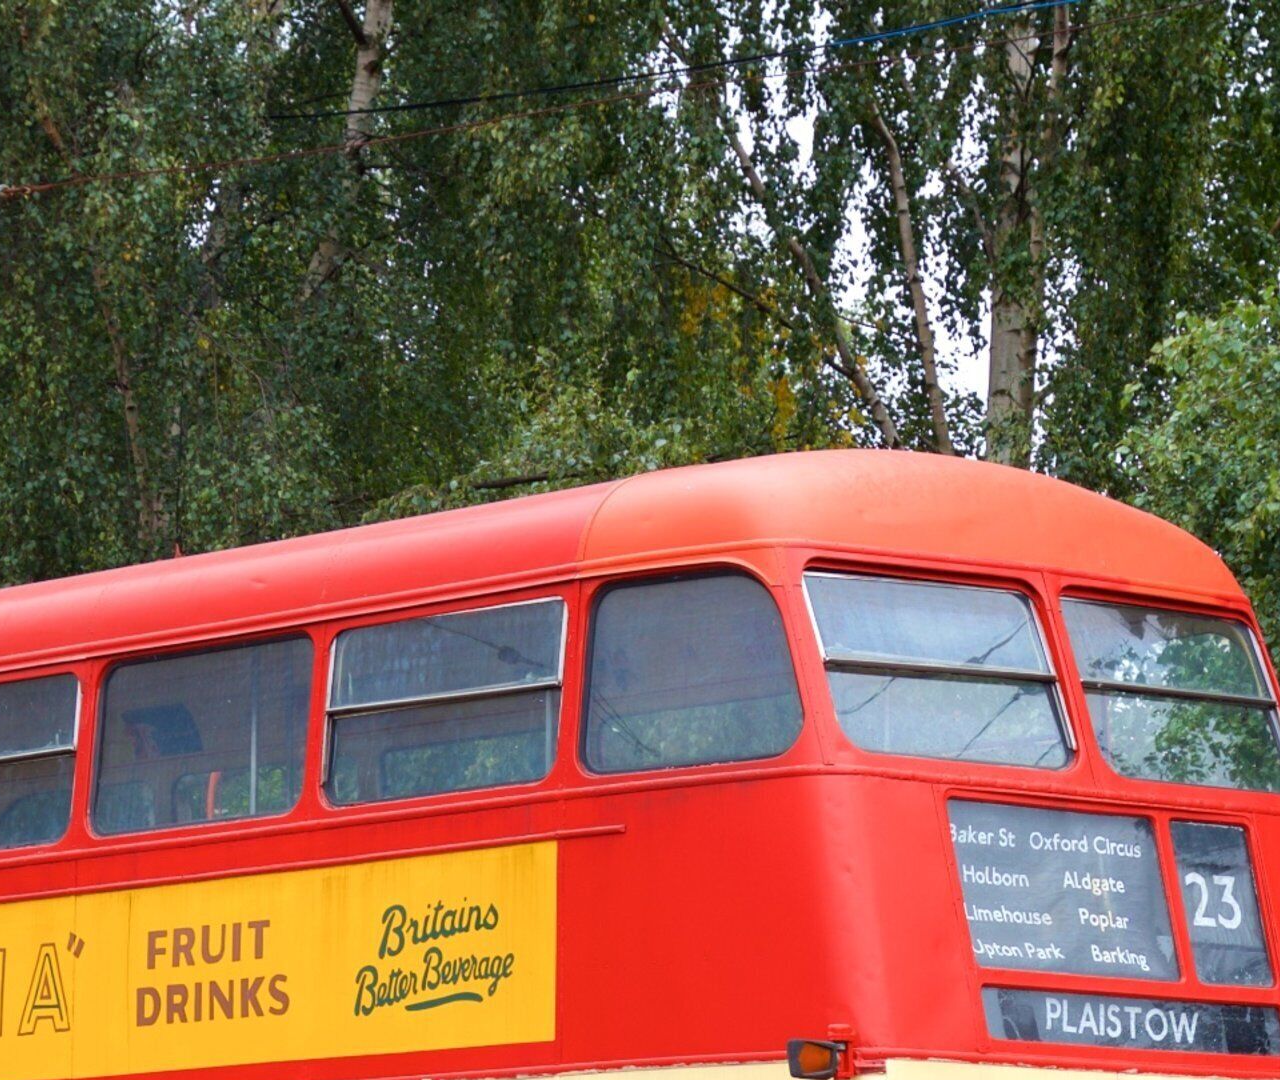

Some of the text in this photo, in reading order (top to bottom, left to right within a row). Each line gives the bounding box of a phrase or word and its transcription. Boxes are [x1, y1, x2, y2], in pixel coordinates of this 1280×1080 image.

[998, 828, 1016, 848] St
[1029, 831, 1142, 858] Oxford Circus
[962, 864, 1030, 888] Holborn
[1063, 870, 1125, 896] Aldgate
[963, 902, 1053, 925] Limehouse
[1184, 872, 1243, 929] 23
[378, 897, 499, 959] Britains
[1078, 907, 1129, 932] Poplar
[146, 920, 271, 970] FRUIT
[1024, 942, 1066, 960] Park
[1091, 944, 1151, 971] Barking
[354, 946, 515, 1016] Better Beverage
[136, 973, 291, 1027] DRINKS
[1045, 997, 1199, 1044] PLAISTOW
